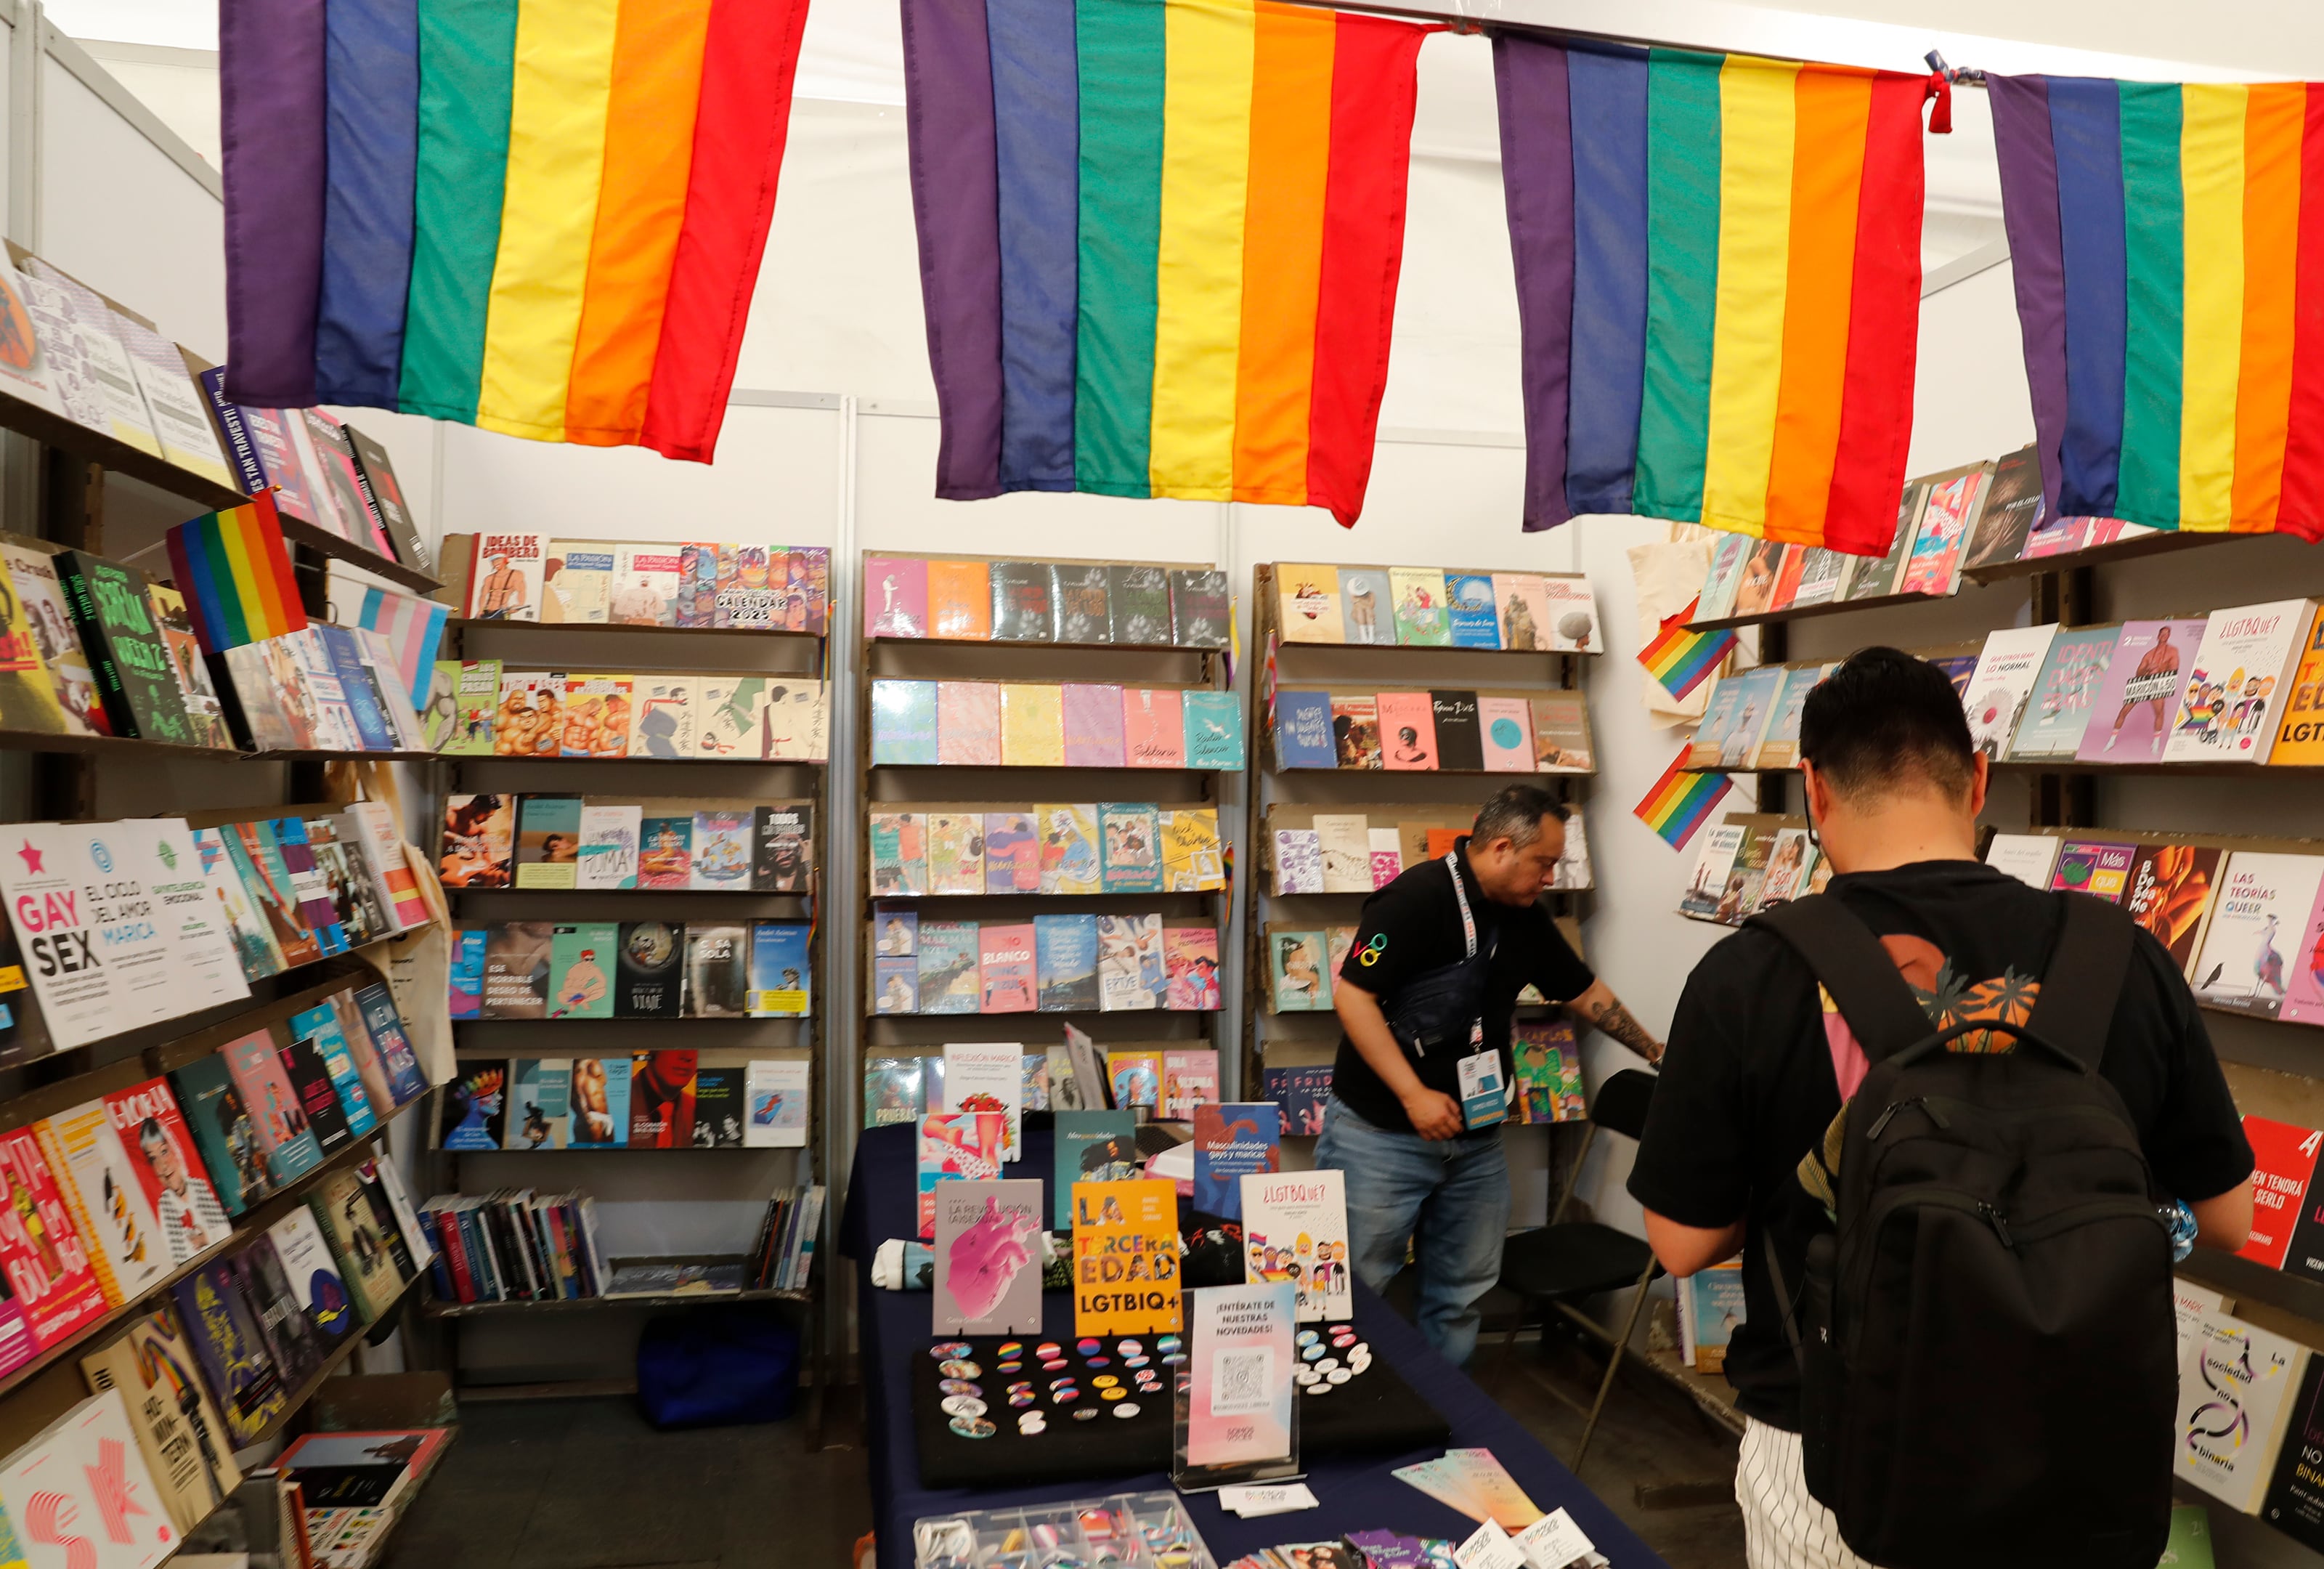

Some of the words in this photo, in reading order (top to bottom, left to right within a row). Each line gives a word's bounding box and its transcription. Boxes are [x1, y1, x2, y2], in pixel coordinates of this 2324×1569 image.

[241, 458, 260, 481] TAN
[487, 535, 521, 548] IDEAS
[523, 535, 539, 547] DE
[715, 595, 789, 611] CALENDAR
[1986, 665, 1997, 674] LO
[1997, 660, 2031, 673] NORMAL
[2047, 666, 2105, 688] DADES
[2041, 691, 2096, 710] TRANS
[2101, 851, 2126, 868] Más
[2096, 875, 2119, 891] que
[2232, 872, 2255, 885] LAS
[84, 888, 103, 902] EL
[105, 881, 142, 899] CICLO
[2229, 885, 2277, 901] TEORÍAS
[16, 889, 79, 933] GAY
[118, 901, 153, 920] AMOR
[2225, 900, 2262, 915] QUEER
[102, 921, 157, 947] MARICA
[31, 930, 101, 977] SEX
[983, 952, 1031, 965] BLANCO
[487, 975, 535, 984] HORRIBLE
[521, 986, 534, 994] DE
[485, 997, 544, 1007] PERTENECER
[107, 1084, 176, 1131] GLORIA
[1206, 1140, 1269, 1151] Masculinidades
[2298, 1130, 2323, 1158] A
[1208, 1151, 1227, 1161] gays
[1235, 1150, 1267, 1159] maricas
[2267, 1173, 2304, 1198] TENDRÁ
[2254, 1192, 2286, 1210] SERLO
[948, 1205, 961, 1215] LA
[1079, 1196, 1126, 1227] LA
[1078, 1233, 1176, 1257] TERCERA
[1079, 1254, 1177, 1285] EDAD
[1081, 1292, 1179, 1315] LGTBIQ+
[1216, 1300, 1264, 1315] ¡ENTÉRATE
[1264, 1300, 1275, 1310] DE
[1222, 1313, 1269, 1325] NUESTRAS
[1216, 1324, 1273, 1337] NOVEDADES!
[2270, 1351, 2286, 1367] La
[2206, 1358, 2253, 1384] sociedad
[2217, 1387, 2232, 1403] no
[2197, 1446, 2235, 1474] binaria
[2301, 1445, 2323, 1465] NO
